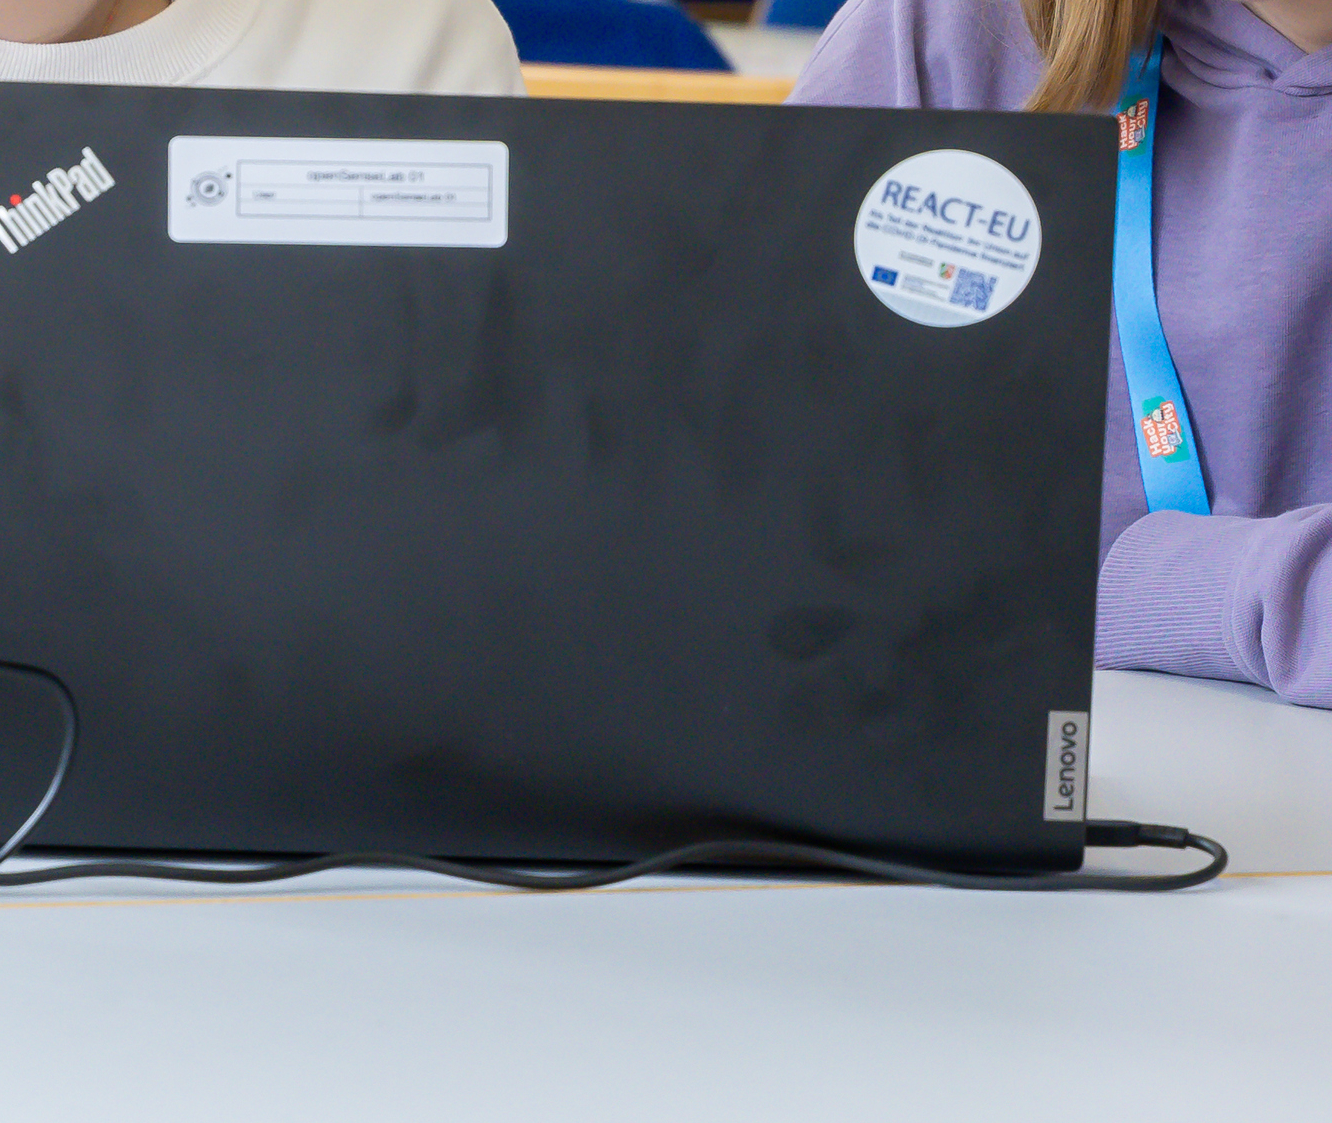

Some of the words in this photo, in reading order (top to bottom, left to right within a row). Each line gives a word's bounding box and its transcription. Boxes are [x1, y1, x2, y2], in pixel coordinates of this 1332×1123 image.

[881, 179, 1031, 242] REACT-EU
[1143, 419, 1163, 456] Hack
[1052, 721, 1077, 811] Lenovo
